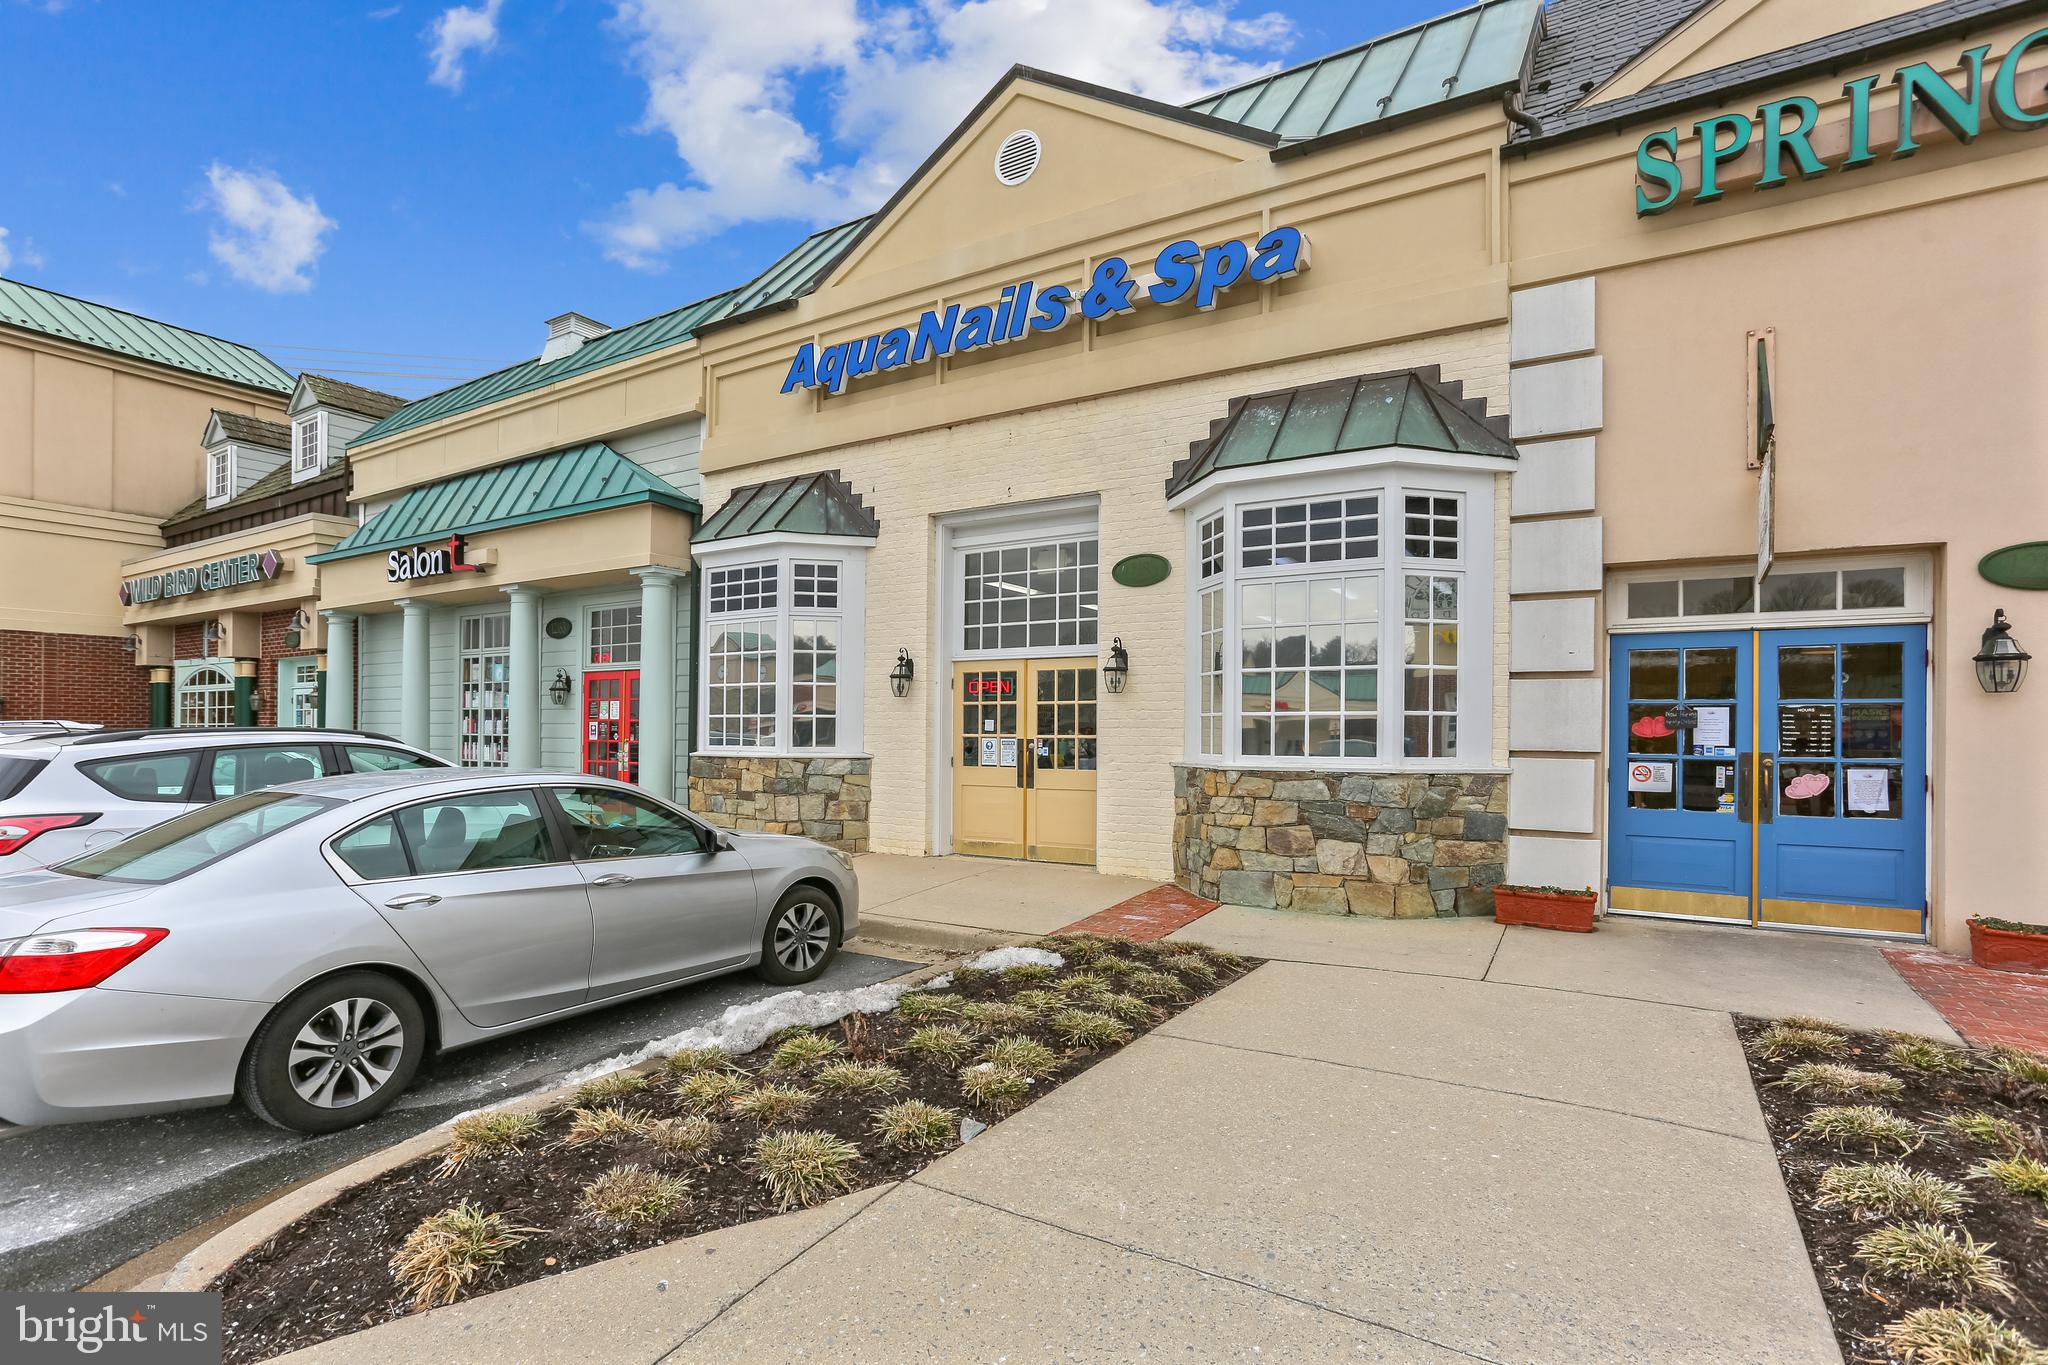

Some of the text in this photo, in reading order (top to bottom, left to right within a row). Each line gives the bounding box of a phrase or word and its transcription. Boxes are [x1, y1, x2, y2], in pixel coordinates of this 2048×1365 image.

[1080, 256, 1140, 320] &
[1148, 226, 1304, 311] Spa
[130, 552, 260, 604] WILD BIRD CENTER
[387, 546, 445, 581] Salon
[968, 680, 1010, 693] OPEN
